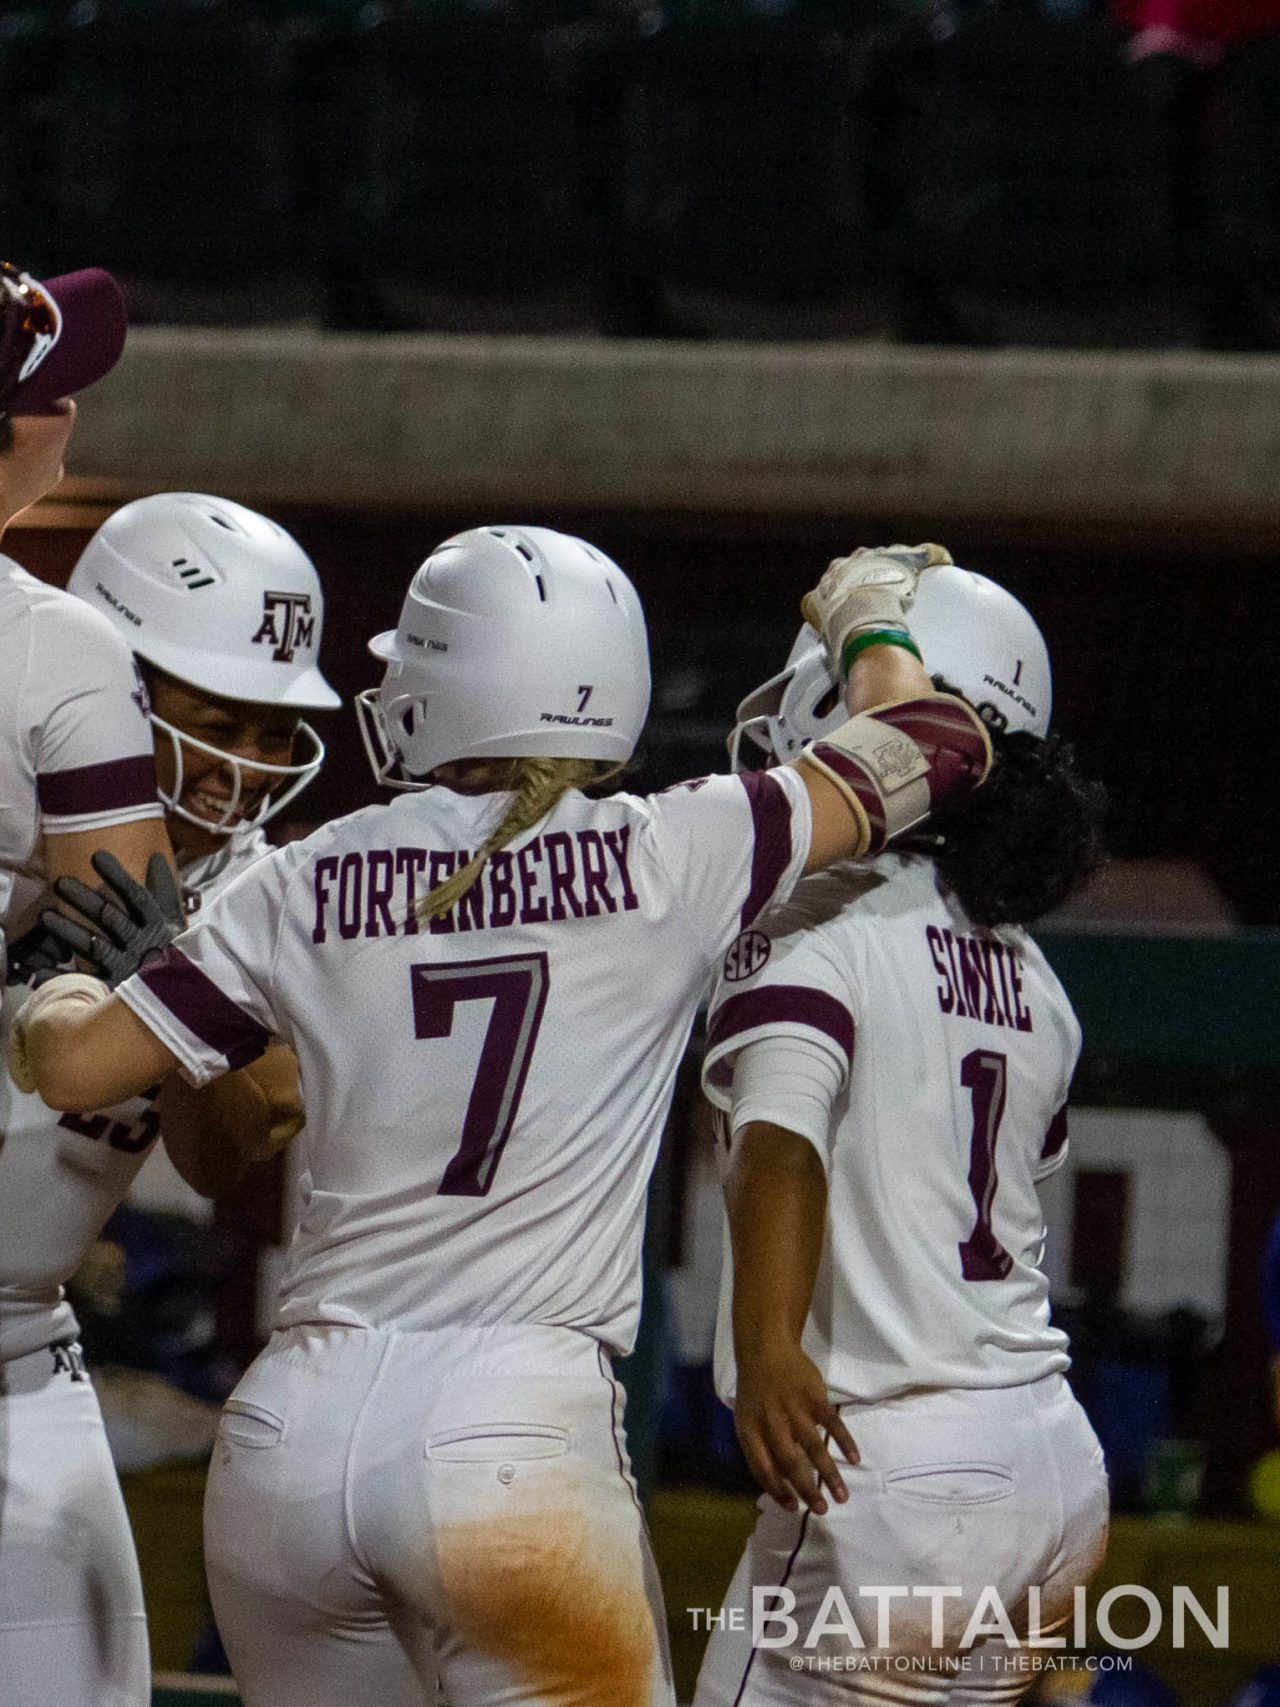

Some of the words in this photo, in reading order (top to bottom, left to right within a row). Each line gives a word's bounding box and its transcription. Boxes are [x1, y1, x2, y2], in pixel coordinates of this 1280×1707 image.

[576, 685, 594, 713] 7
[1013, 659, 1023, 687] 1
[539, 712, 614, 727] RAWLINGS
[312, 823, 640, 945] FORTENBERRY
[723, 929, 772, 982] SEC
[410, 951, 550, 1197] 7
[957, 1048, 1014, 1282] 1
